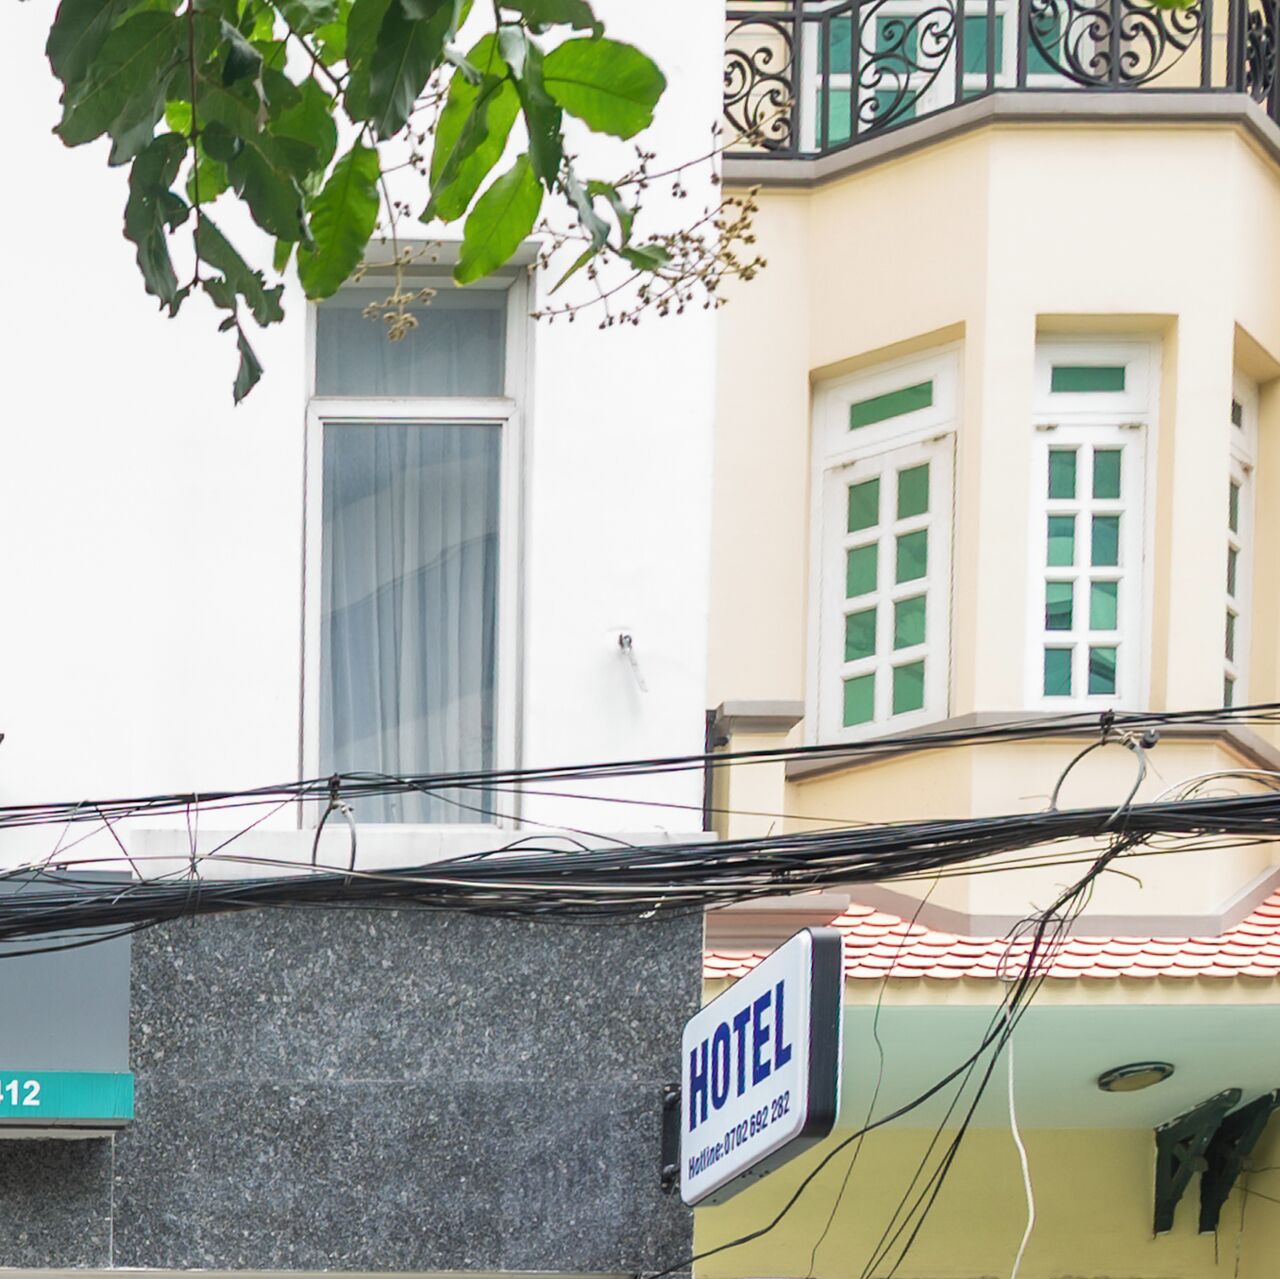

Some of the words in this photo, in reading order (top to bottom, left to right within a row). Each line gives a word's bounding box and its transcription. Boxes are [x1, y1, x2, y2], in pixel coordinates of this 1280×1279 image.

[688, 978, 793, 1133] HOTEL
[749, 1108, 769, 1138] 692
[771, 1090, 791, 1123] 282
